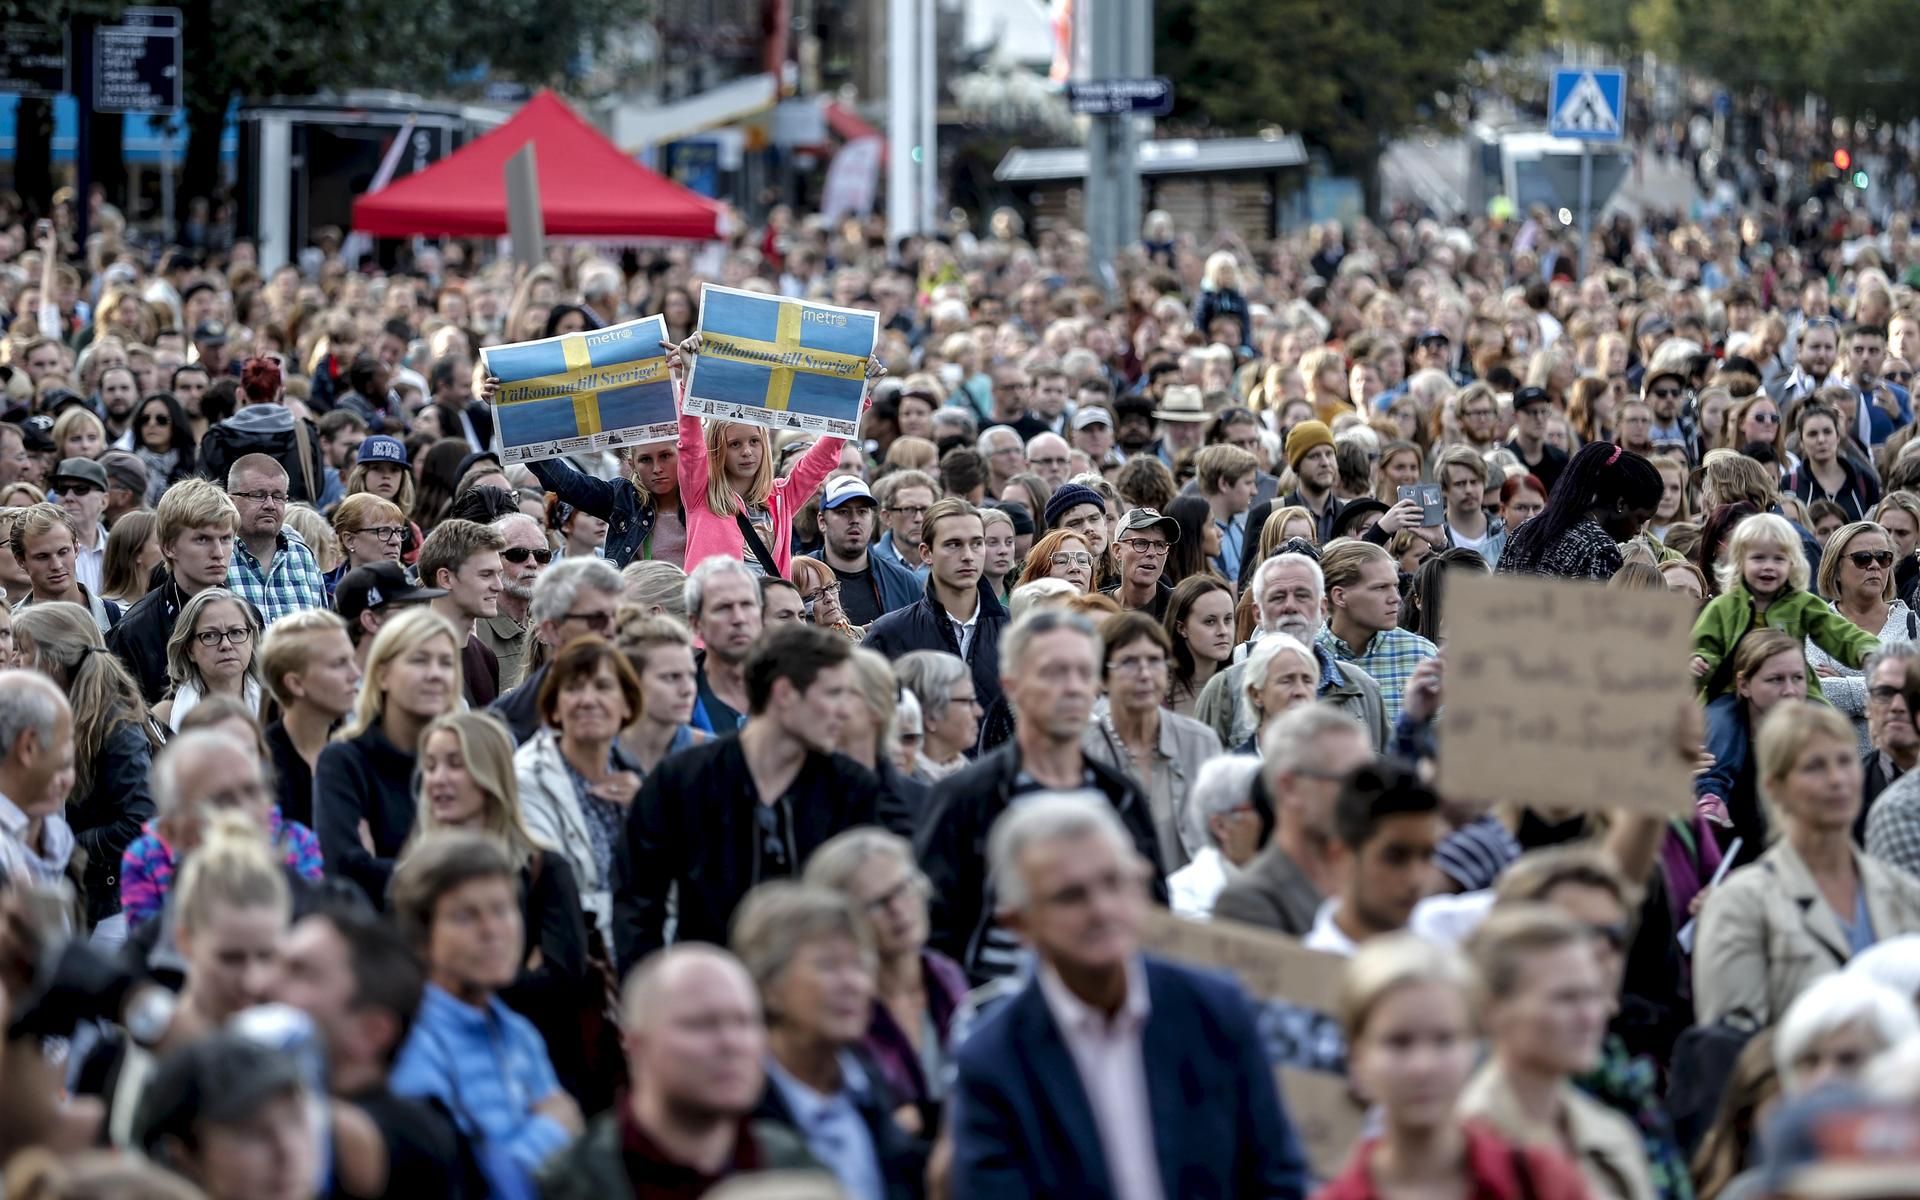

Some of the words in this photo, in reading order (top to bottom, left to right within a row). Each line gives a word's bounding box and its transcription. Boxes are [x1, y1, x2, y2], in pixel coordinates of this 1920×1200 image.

[803, 310, 848, 327] metro
[587, 329, 633, 346] metro
[780, 352, 803, 366] till
[804, 353, 861, 377] Sverige!
[500, 383, 576, 403] Välkomna
[576, 373, 598, 391] till
[601, 362, 658, 385] Sverige!
